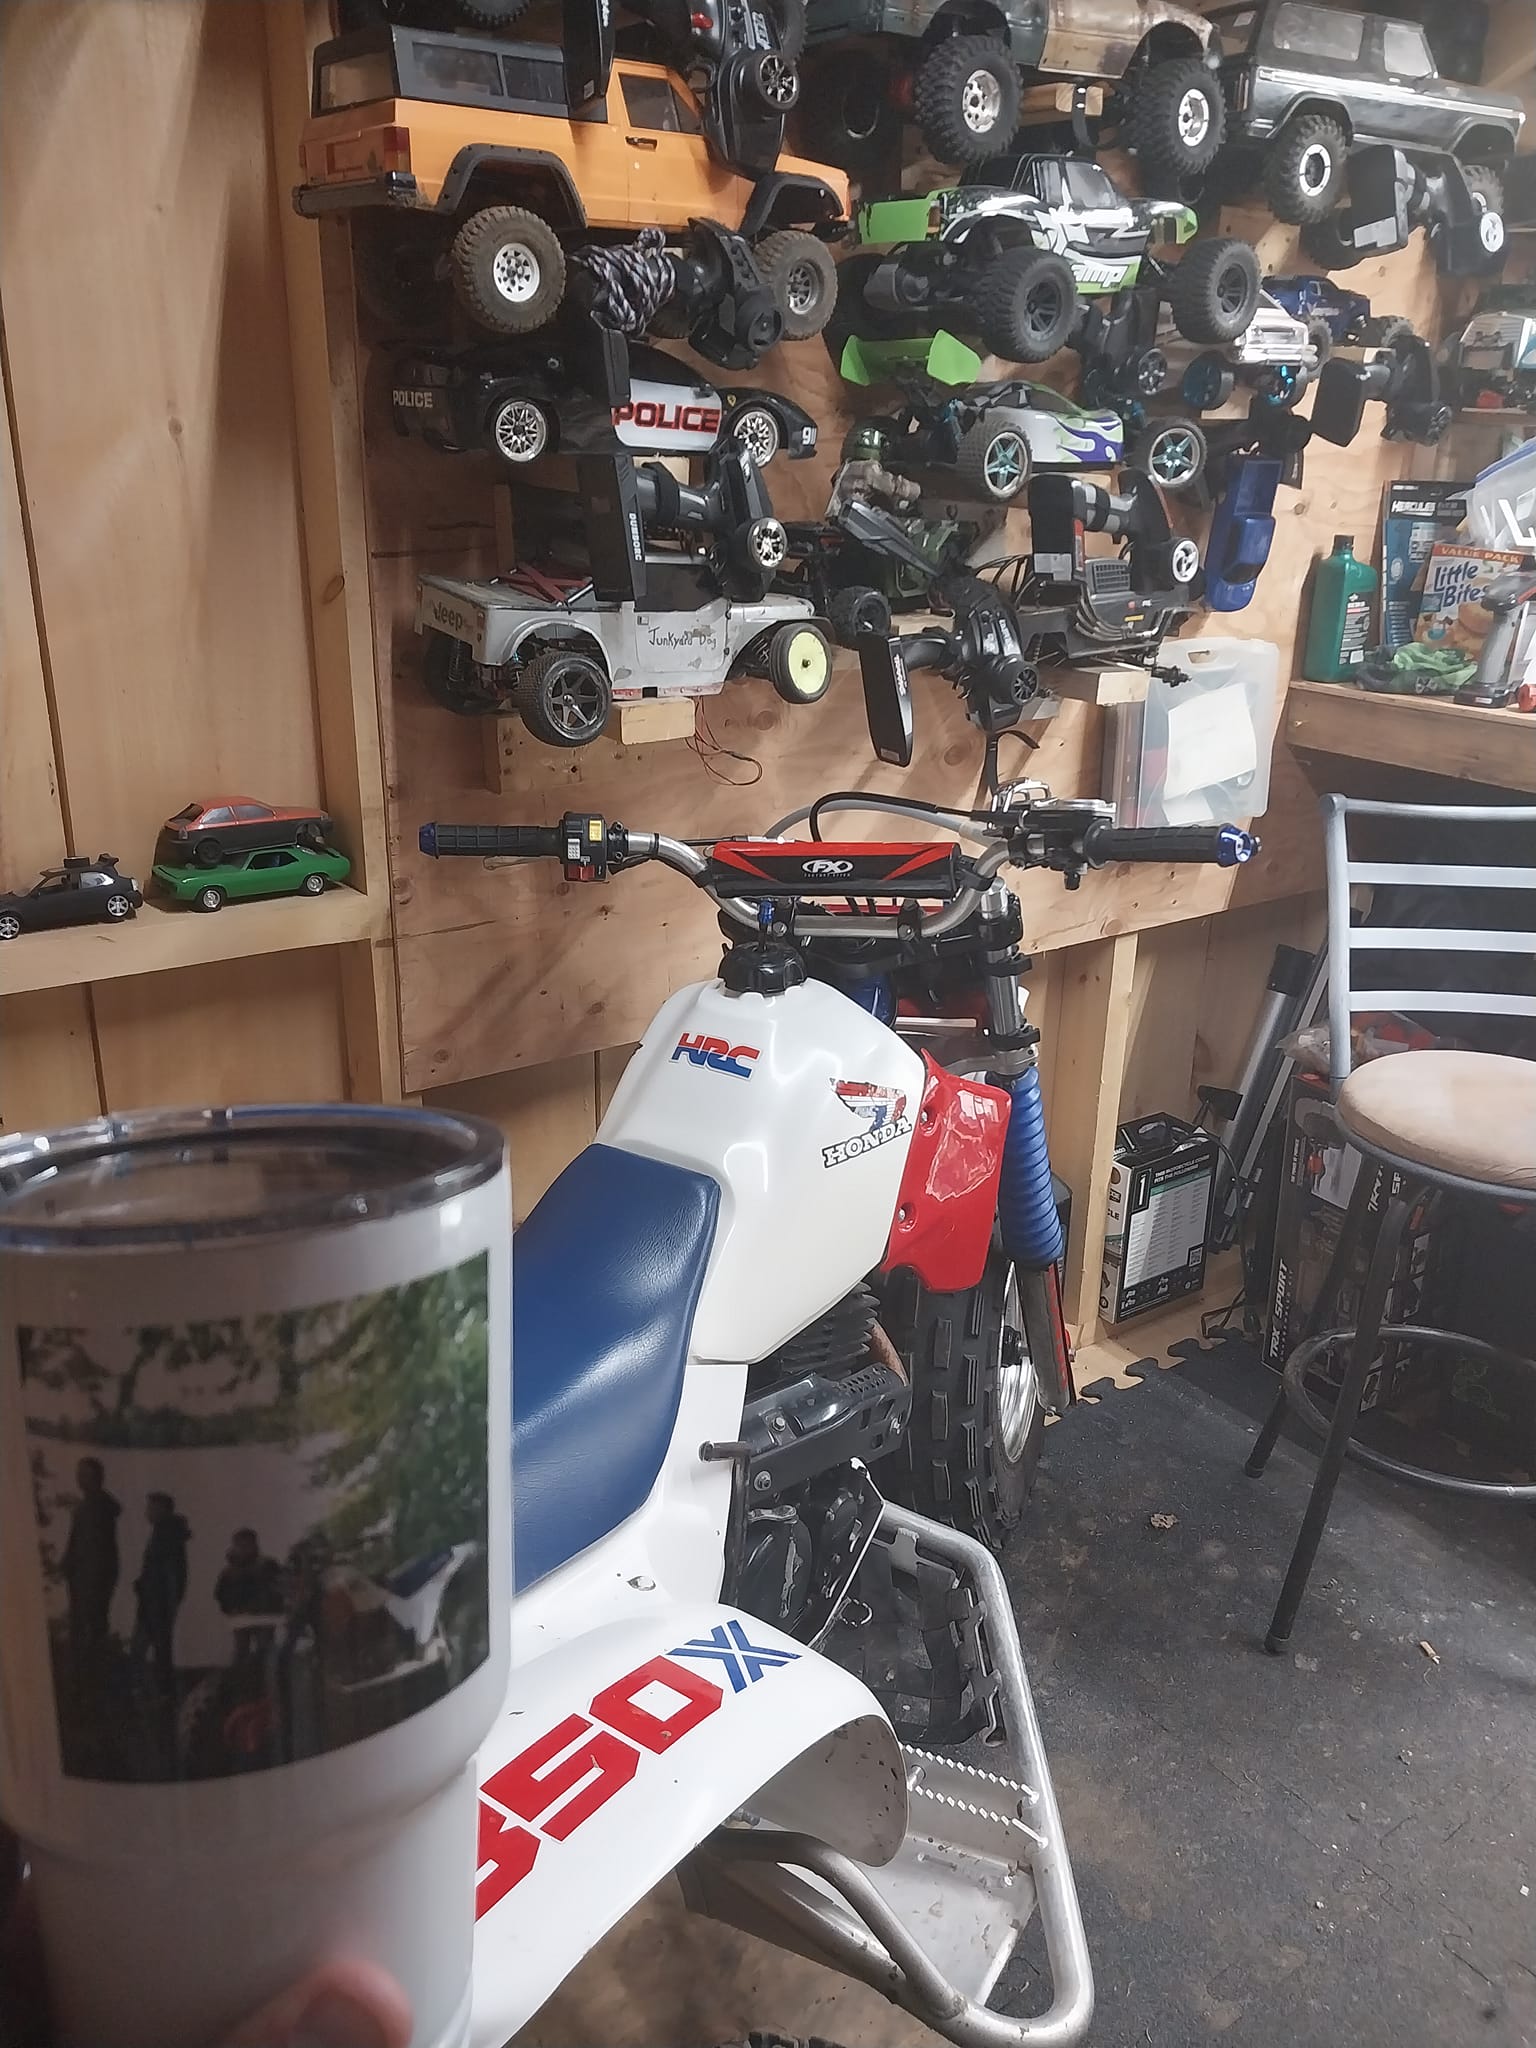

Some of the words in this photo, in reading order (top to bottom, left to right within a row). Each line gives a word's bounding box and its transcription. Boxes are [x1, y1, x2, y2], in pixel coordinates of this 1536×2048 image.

[393, 390, 433, 408] POLICE
[612, 402, 720, 433] POLICE
[1441, 546, 1480, 556] VALUE
[1484, 552, 1520, 564] PACK
[1434, 561, 1479, 592] Little
[433, 604, 463, 630] Jeep
[699, 633, 726, 650] Dog
[670, 1032, 761, 1079] HRC
[822, 1116, 912, 1168] HONDA
[1275, 1258, 1288, 1319] SPORT
